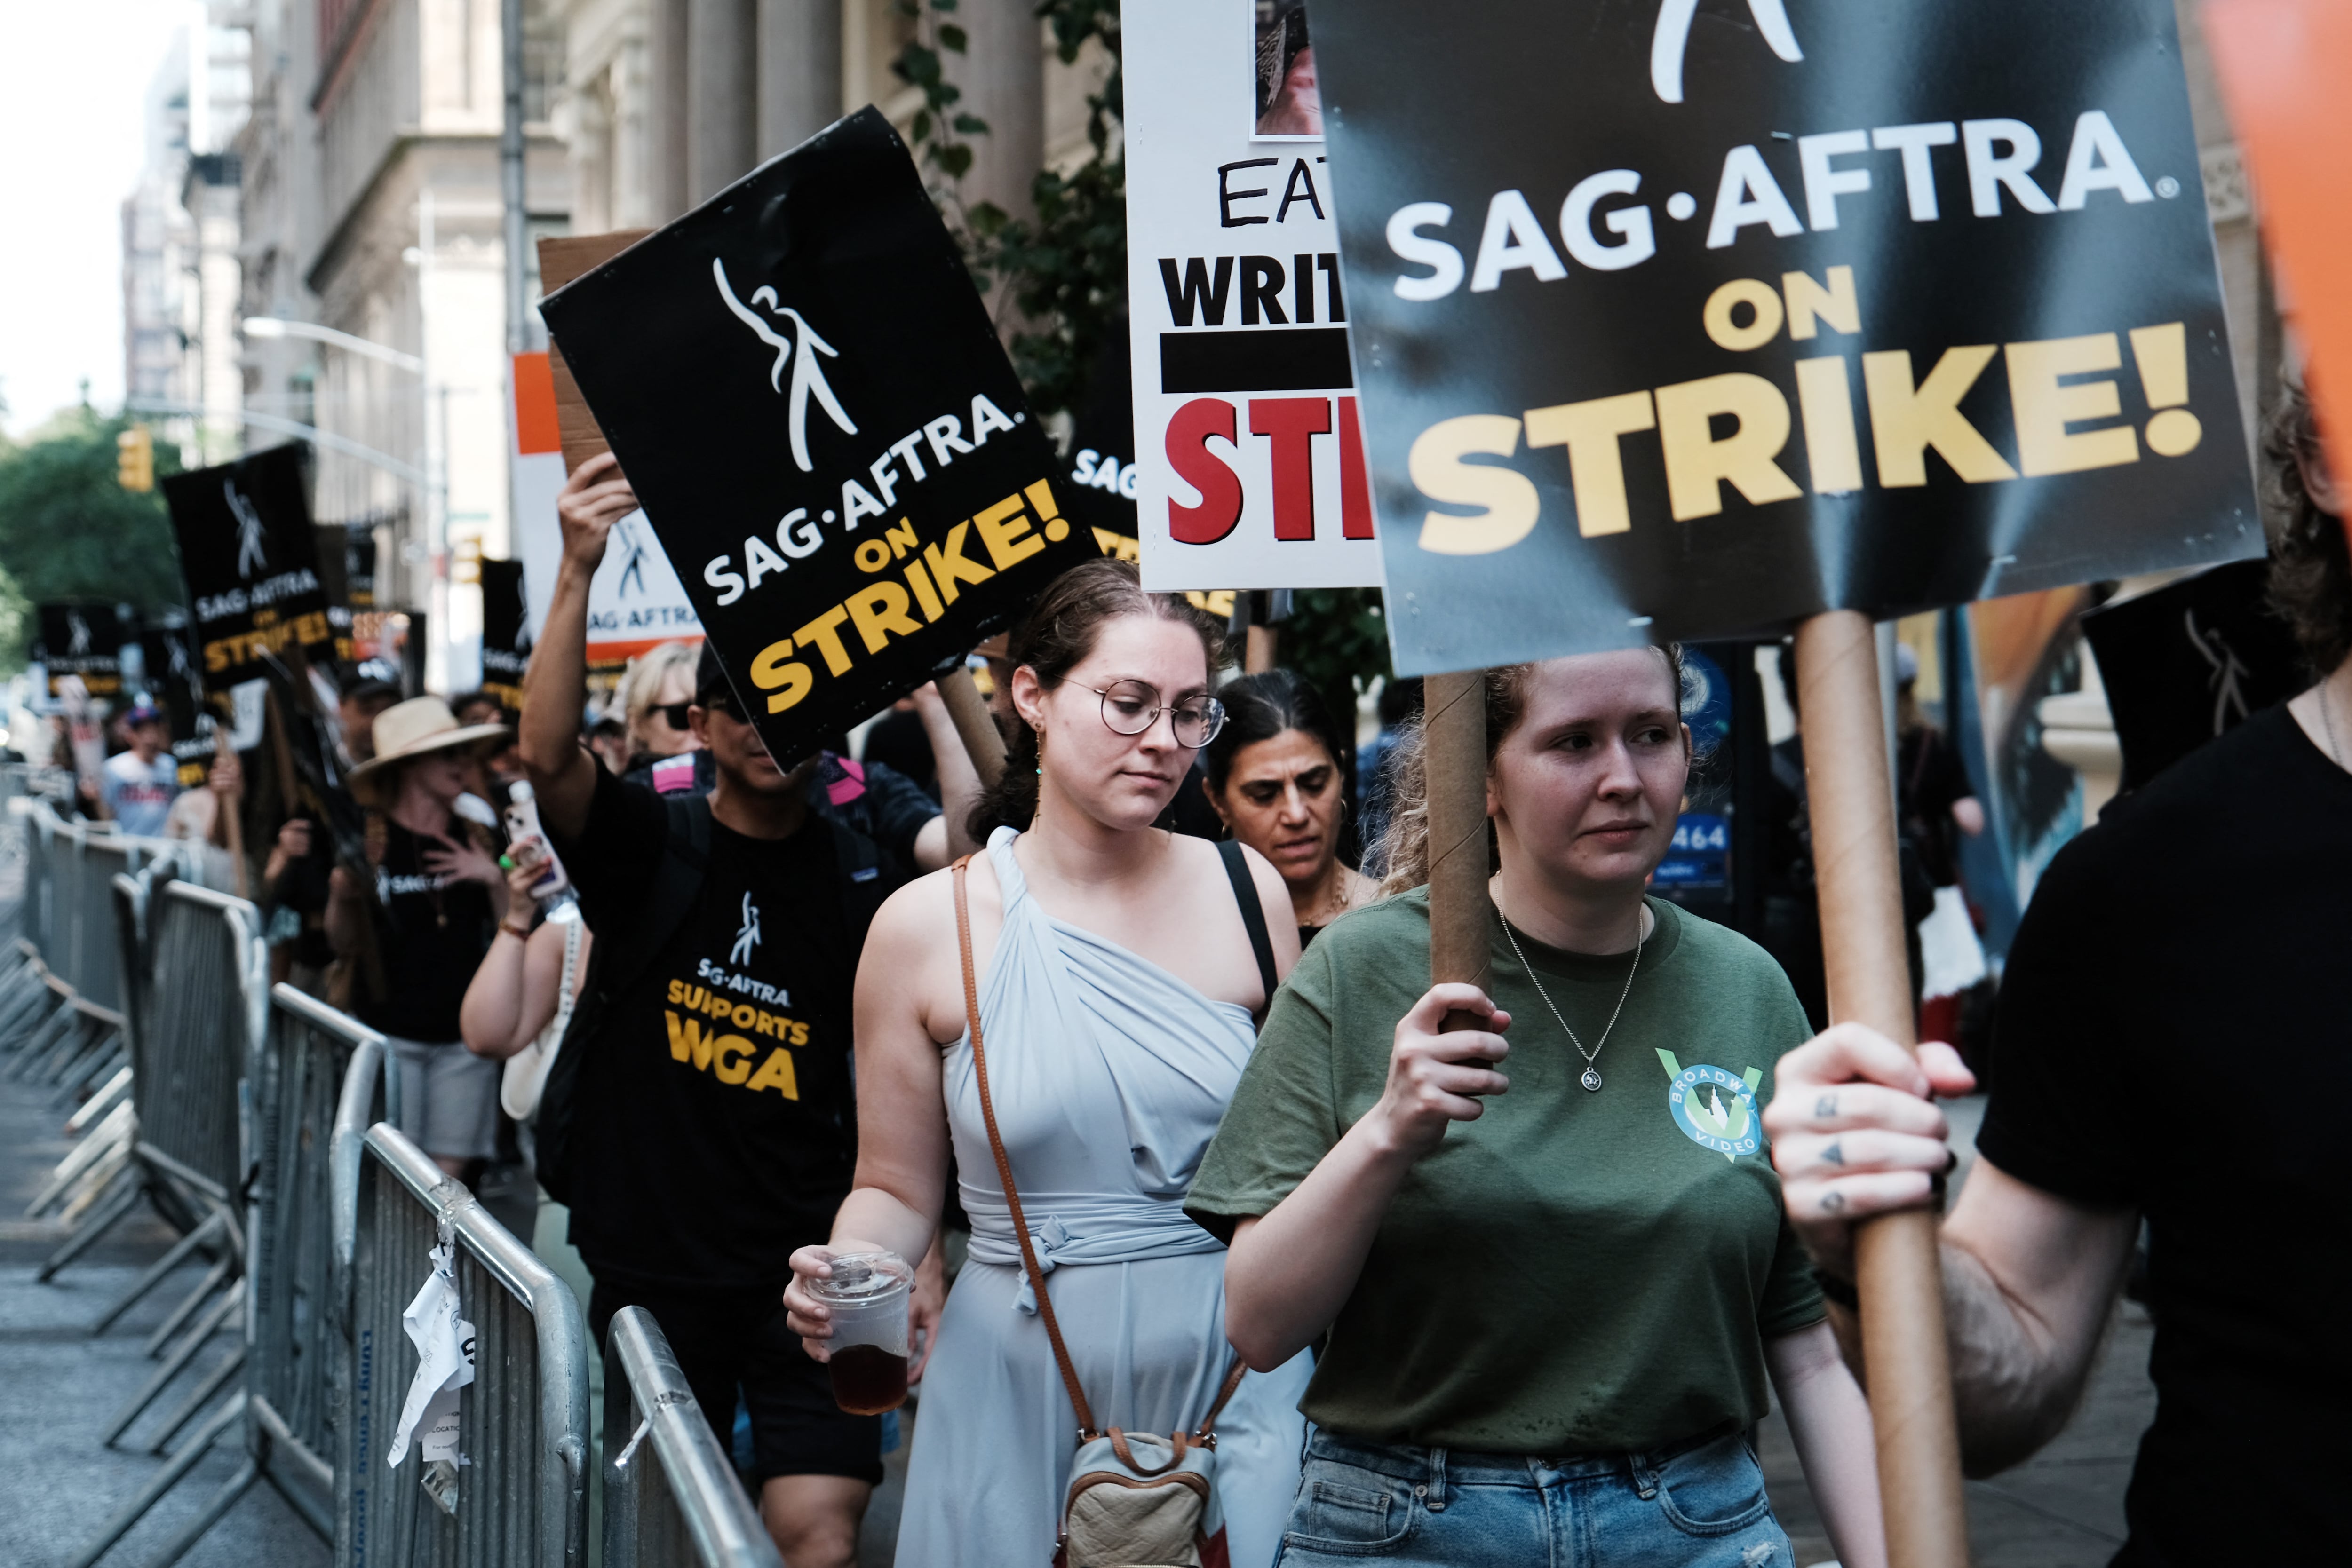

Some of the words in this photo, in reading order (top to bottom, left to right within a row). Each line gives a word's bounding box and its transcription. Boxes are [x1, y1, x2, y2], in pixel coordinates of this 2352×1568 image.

[1218, 156, 1329, 228] EA
[1703, 265, 1861, 351] ON
[1408, 322, 2202, 555] STRIKE!
[854, 516, 918, 573] ON
[750, 478, 1069, 714] STRIKE!
[665, 1010, 799, 1101] WGA
[1695, 1131, 1755, 1152] VIDEO
